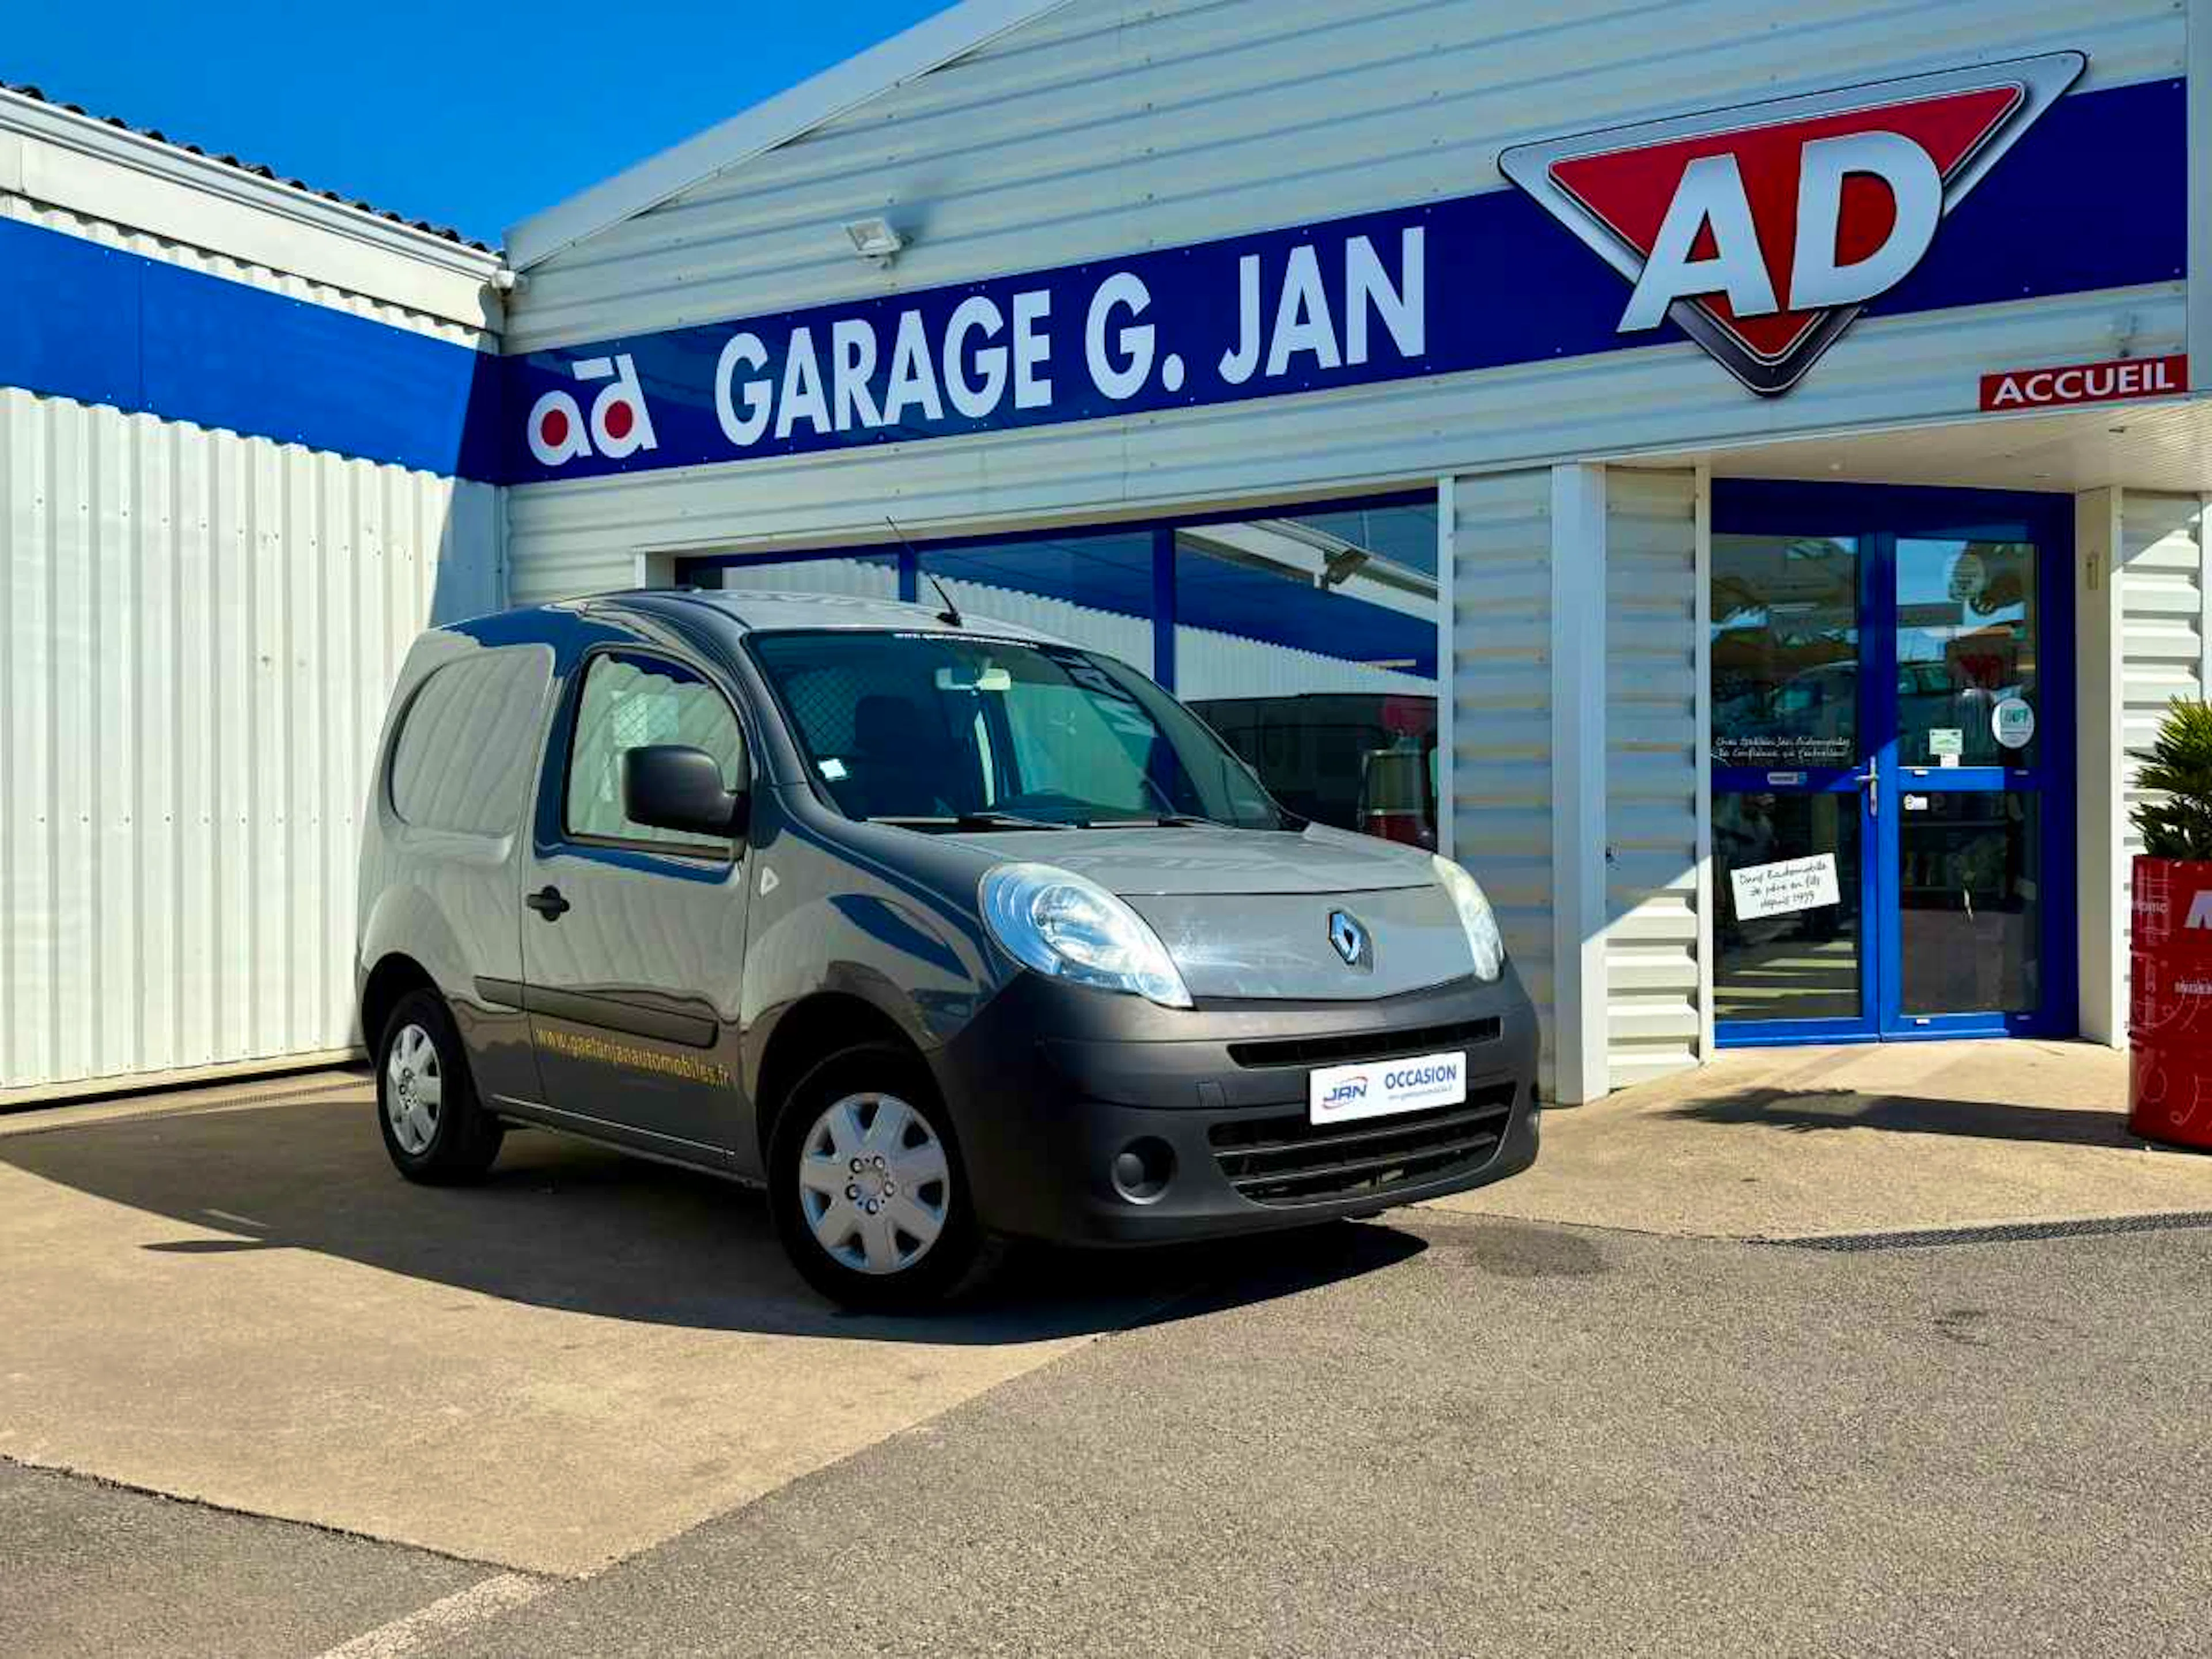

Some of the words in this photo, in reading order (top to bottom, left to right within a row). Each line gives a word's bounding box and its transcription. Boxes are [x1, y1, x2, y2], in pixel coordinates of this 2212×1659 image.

[1616, 130, 1944, 333] AD
[715, 289, 1052, 446] GARAGE
[1085, 272, 1185, 400] G.
[1218, 226, 1425, 384] JAN
[1992, 361, 2175, 407] ACCUEIL
[1323, 1084, 1368, 1103] JAN
[1385, 1065, 1457, 1090] OCCASION
